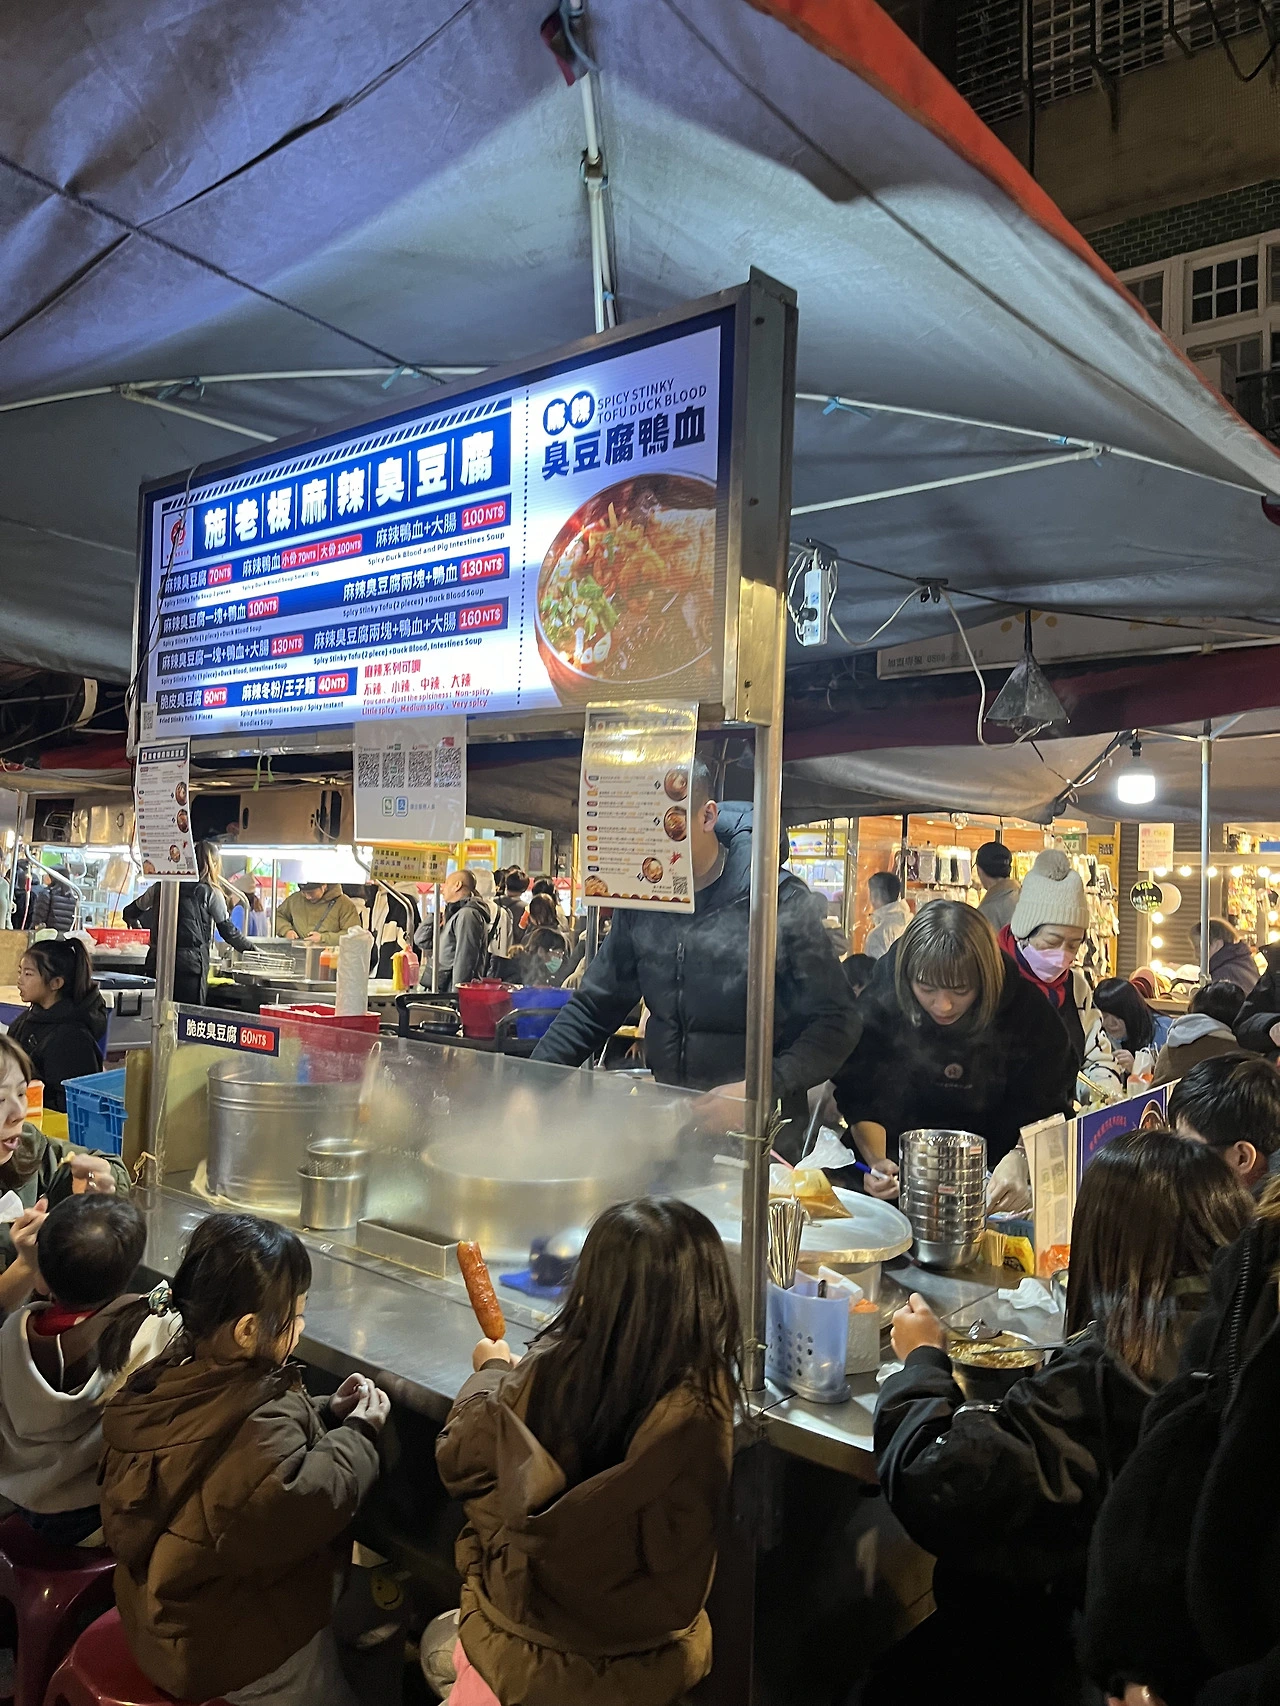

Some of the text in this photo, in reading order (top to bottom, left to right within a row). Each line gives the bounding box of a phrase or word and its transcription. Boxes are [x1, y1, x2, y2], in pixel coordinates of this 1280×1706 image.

[597, 378, 675, 411] SPICY STINKY
[598, 385, 707, 425] TOFU DUCK BLOOD
[542, 405, 706, 481] 臭豆腐鴨血
[204, 430, 494, 550] 施老板麻辣臭豆腐
[375, 512, 457, 548] 麻辣鴨血+大腸
[242, 553, 281, 577] 麻辣鴨血
[320, 542, 336, 559] 大份
[368, 531, 504, 566] Spicy Duck Blood and Pig Intestines Soup
[164, 570, 207, 593] 麻辣臭豆腐
[343, 562, 458, 601] 麻辣臭豆腐兩塊+鴨血
[163, 603, 246, 633] 麻辣臭豆腐一塊+鴨血
[343, 608, 358, 618] Spicy
[359, 604, 378, 615] Stinky
[379, 602, 392, 611] Tofu
[445, 590, 465, 600] Blood
[466, 587, 484, 598] Soup
[313, 612, 456, 650] 麻辣臭豆腐兩塊+鴨血+大腸
[161, 638, 269, 670] 麻辣臭豆腐一塊+鴨血+大腸
[274, 662, 287, 670] Soup
[313, 657, 328, 665] Spicy
[329, 654, 347, 663] Stinky
[348, 652, 360, 660] Tofu
[430, 638, 463, 649] Intestines
[464, 636, 482, 646] Soup
[240, 709, 253, 717] Spicy
[254, 707, 267, 715] Glass
[268, 705, 289, 714] Noodles
[290, 704, 303, 713] Soup
[307, 702, 322, 711] Spicy
[323, 700, 343, 709] Instant
[362, 707, 377, 715] Little
[400, 703, 426, 712] Medium
[451, 699, 468, 709] Very
[469, 697, 487, 708] spicy
[386, 695, 406, 704] adjust
[407, 693, 417, 701] the
[159, 716, 170, 724] Fried
[260, 718, 273, 726] Soup
[186, 1018, 267, 1046] 脆皮臭豆腐 60NT$
